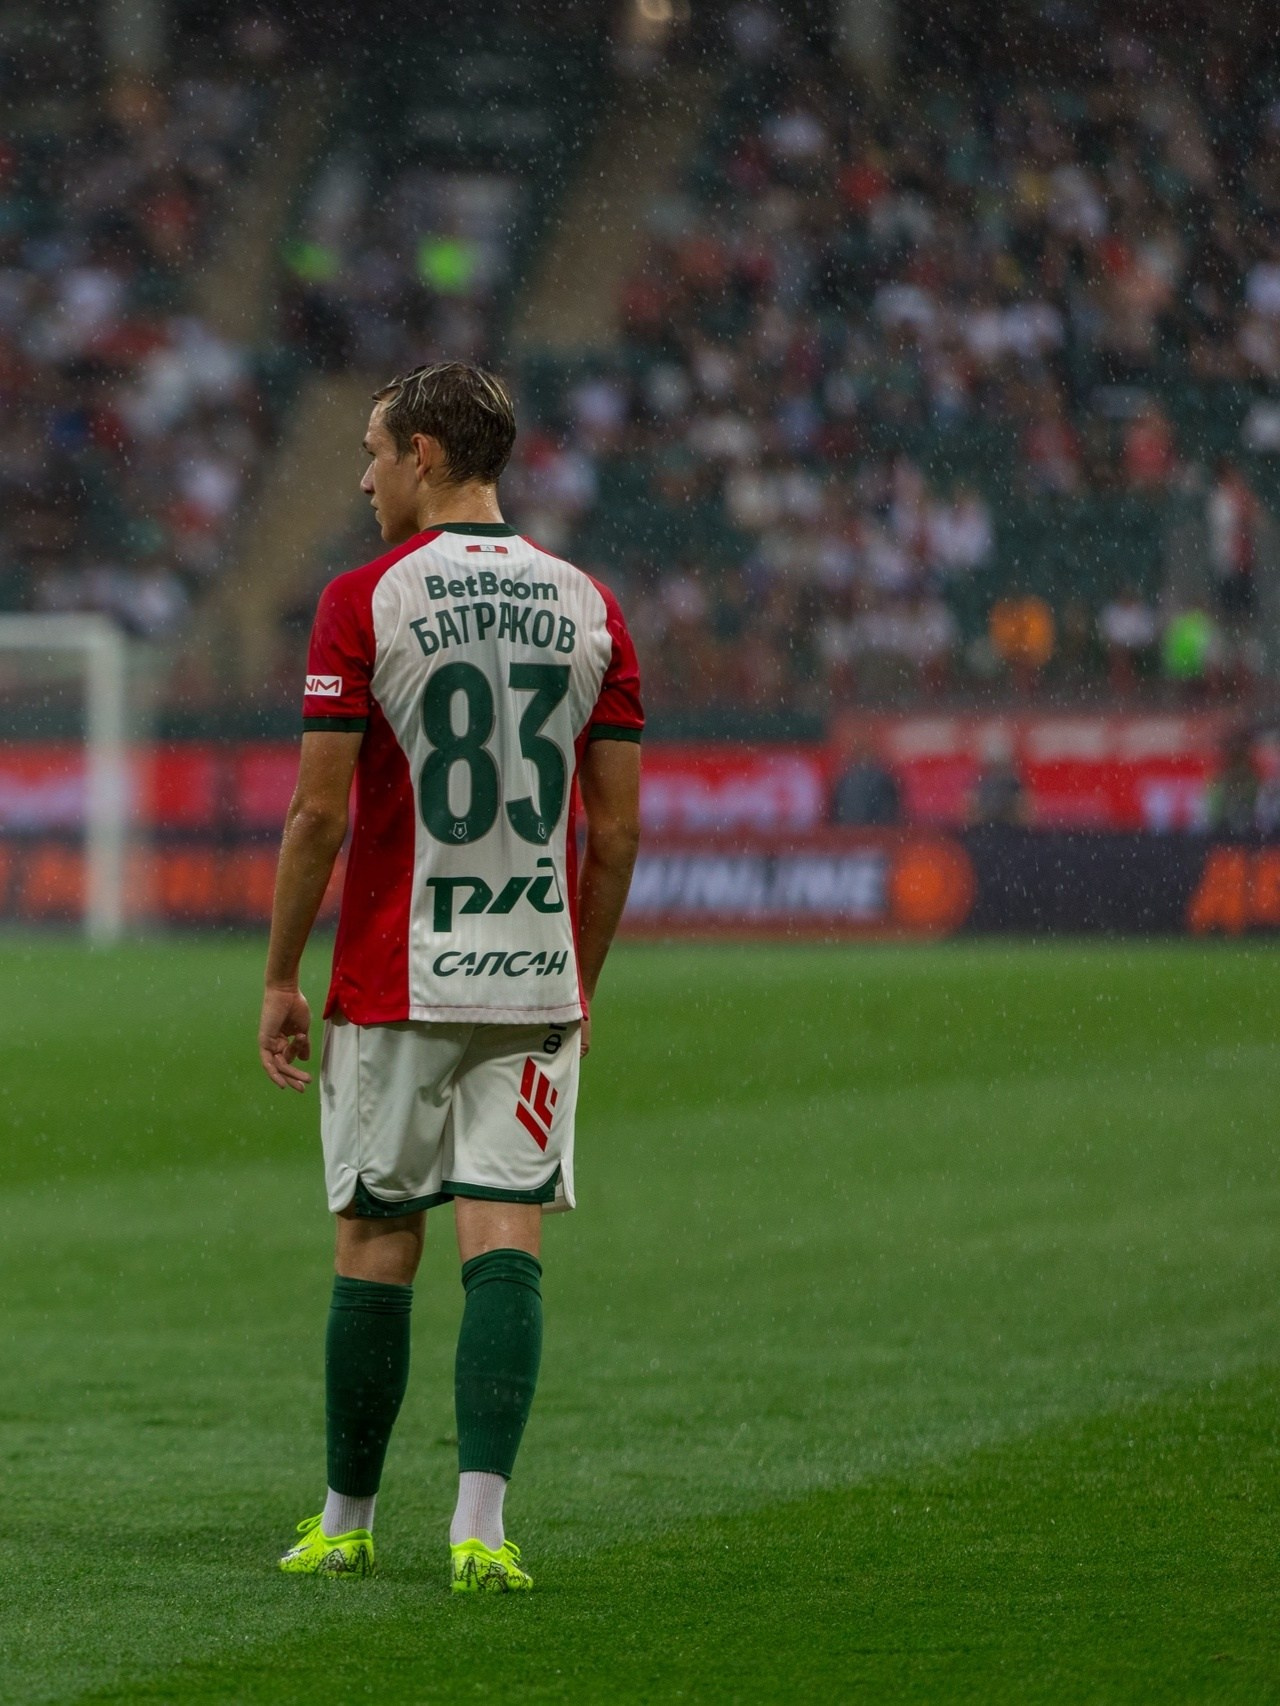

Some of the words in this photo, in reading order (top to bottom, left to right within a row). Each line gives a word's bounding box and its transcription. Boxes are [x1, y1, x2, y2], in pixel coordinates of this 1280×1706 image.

[424, 571, 558, 601] BetBoom
[409, 601, 576, 657] БАТРАКОВ
[420, 662, 571, 846] 83
[432, 950, 569, 977] САПСАН
